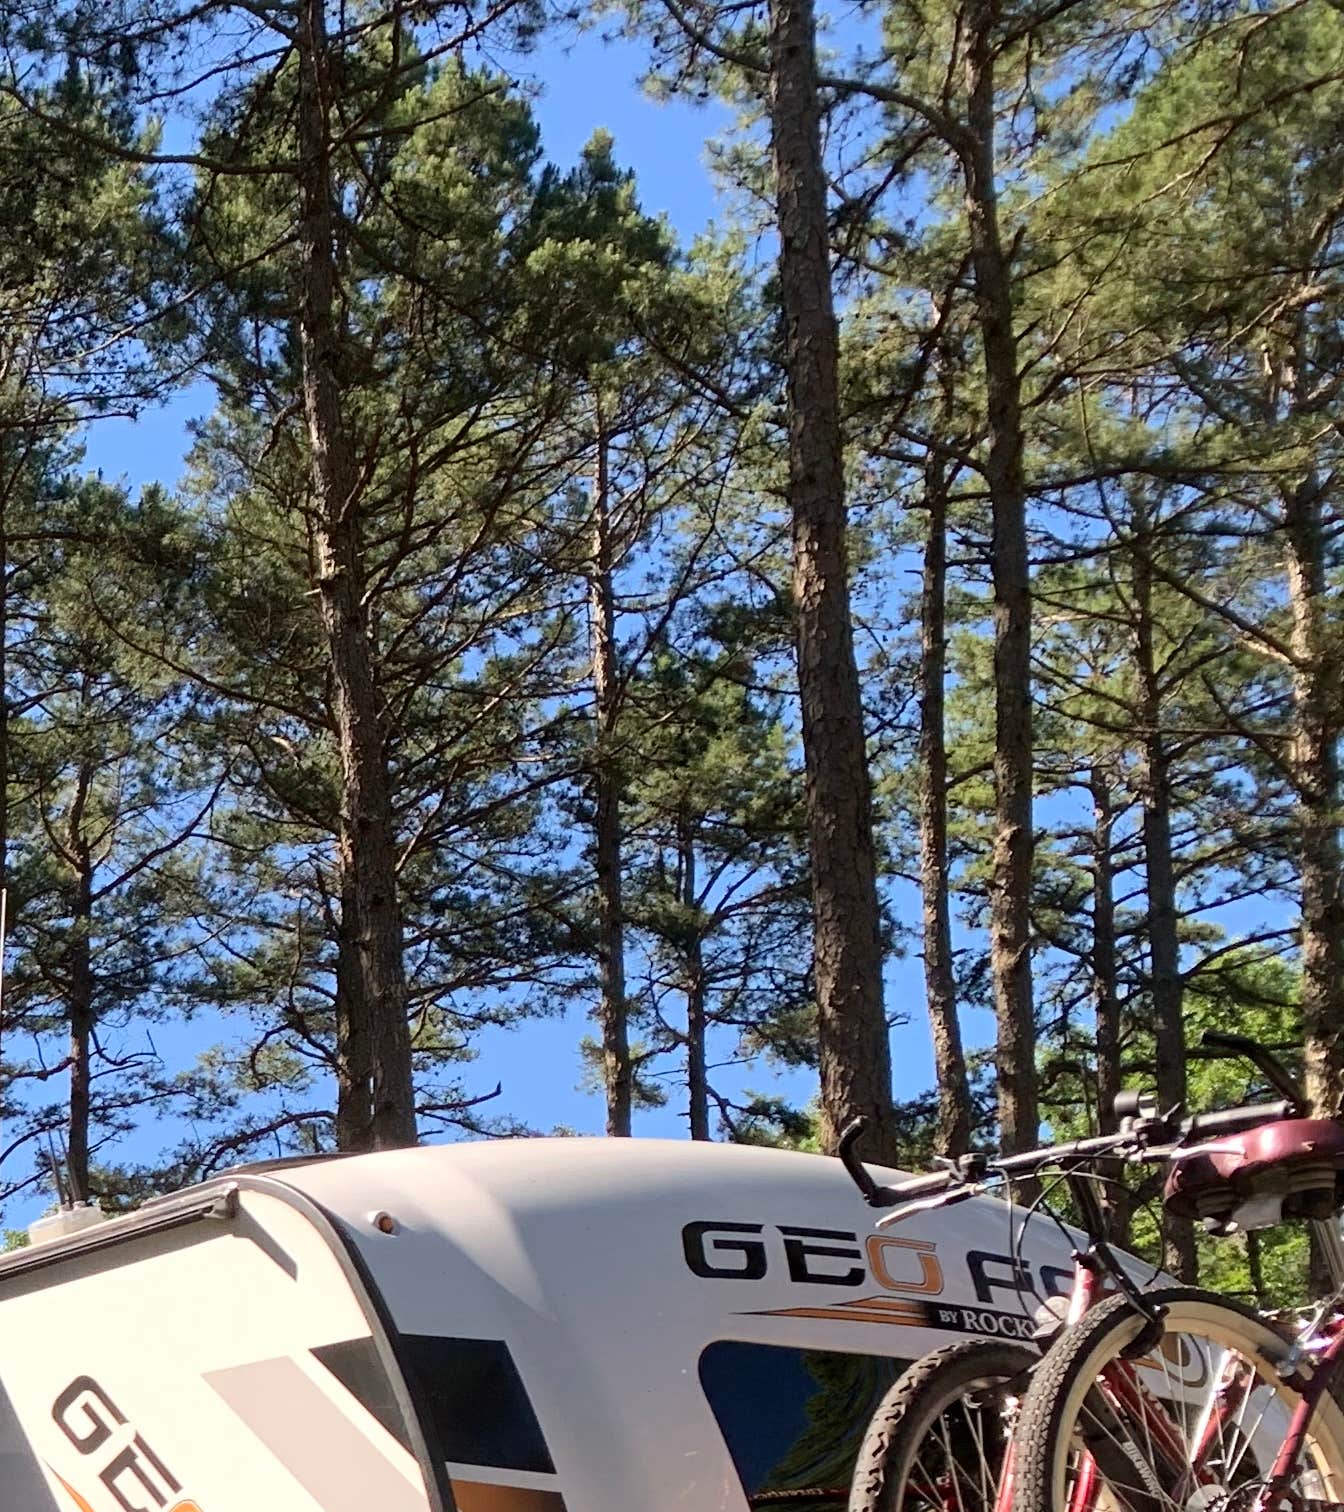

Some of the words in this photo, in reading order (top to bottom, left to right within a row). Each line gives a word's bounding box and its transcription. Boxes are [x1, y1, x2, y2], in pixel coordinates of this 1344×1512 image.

[683, 1219, 944, 1296] GEO
[938, 1310, 958, 1324] BY
[959, 1309, 1036, 1339] ROCK
